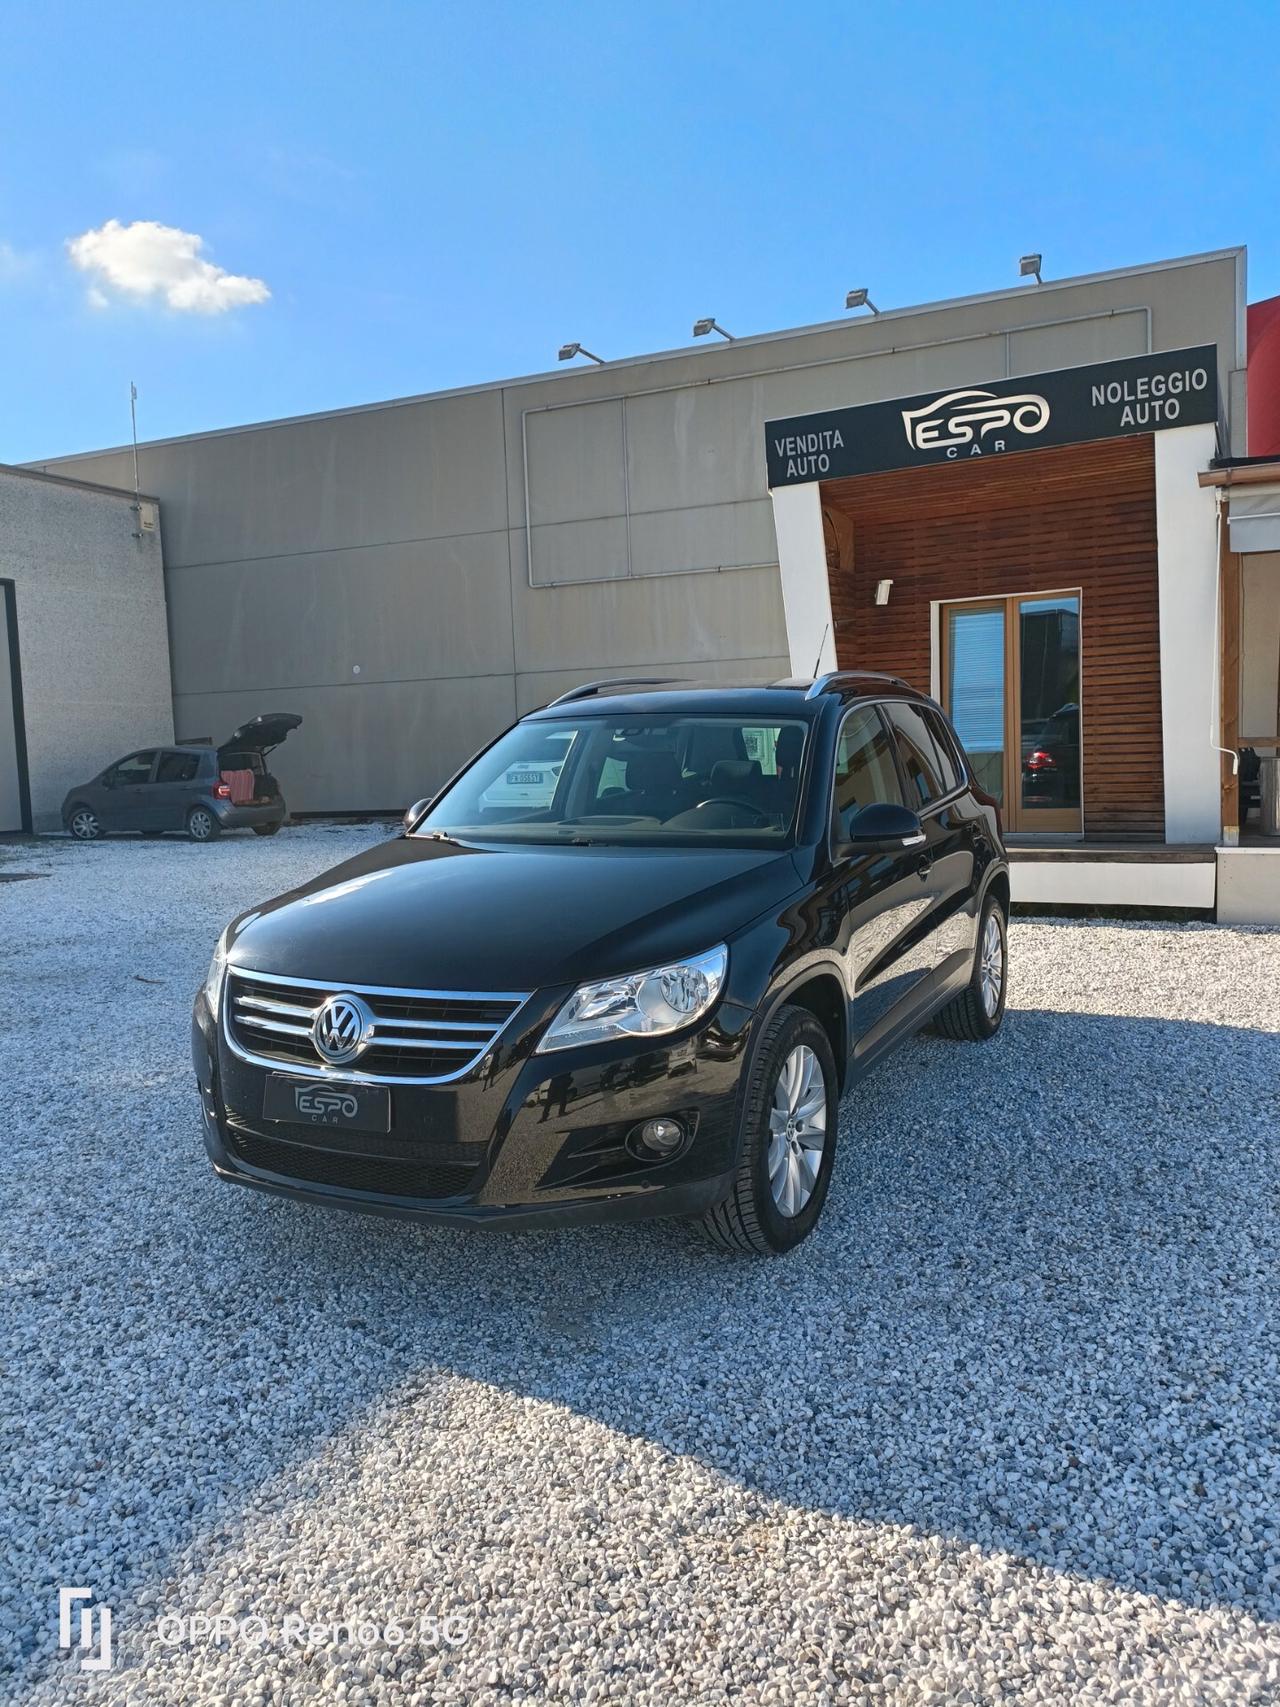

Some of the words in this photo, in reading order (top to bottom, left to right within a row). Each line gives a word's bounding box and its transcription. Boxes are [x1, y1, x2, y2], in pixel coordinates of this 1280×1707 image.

[1091, 368, 1208, 407] NOLEGGIO
[914, 393, 1050, 450] ESPO
[1120, 398, 1180, 427] AUTO
[774, 429, 845, 457] VENDITA
[946, 440, 1006, 458] CAR
[786, 453, 830, 478] AUTO
[299, 1090, 358, 1118] ESPO
[311, 1114, 338, 1124] CAR
